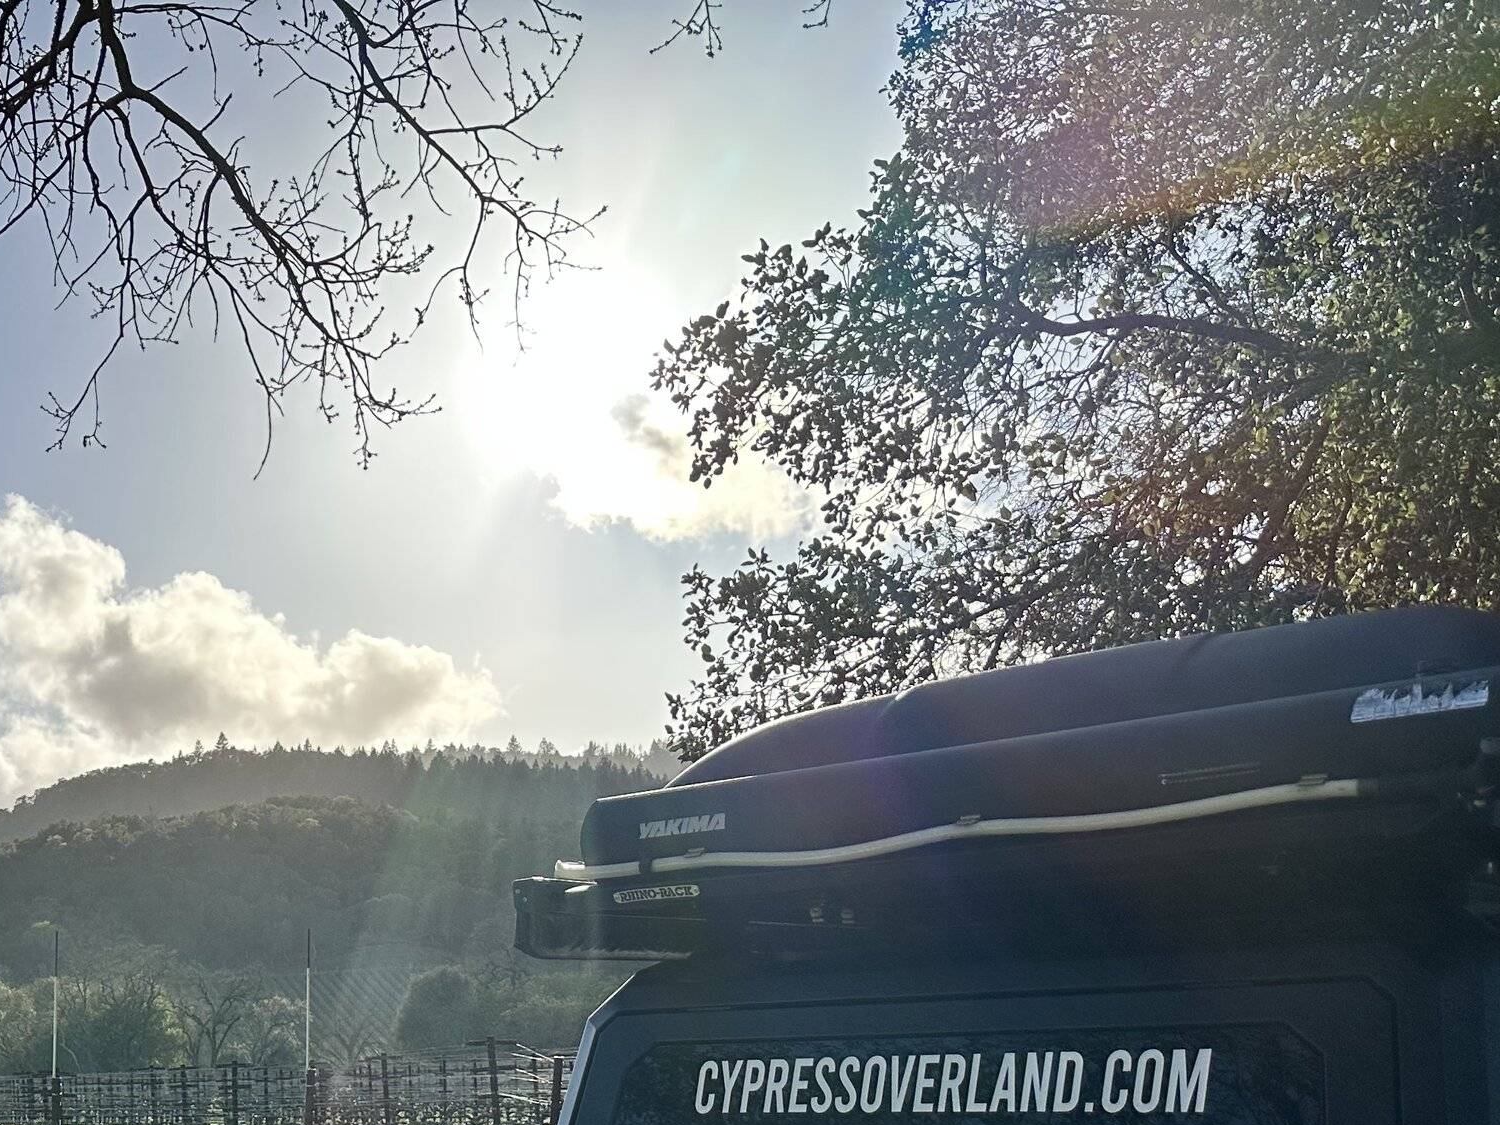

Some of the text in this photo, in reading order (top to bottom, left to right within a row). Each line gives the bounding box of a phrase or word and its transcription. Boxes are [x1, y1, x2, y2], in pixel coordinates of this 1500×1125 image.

[639, 812, 726, 839] YAKIMA
[619, 886, 694, 903] RHINO-RACK
[694, 1048, 1212, 1115] CYPRESSOVERLAND.COM
